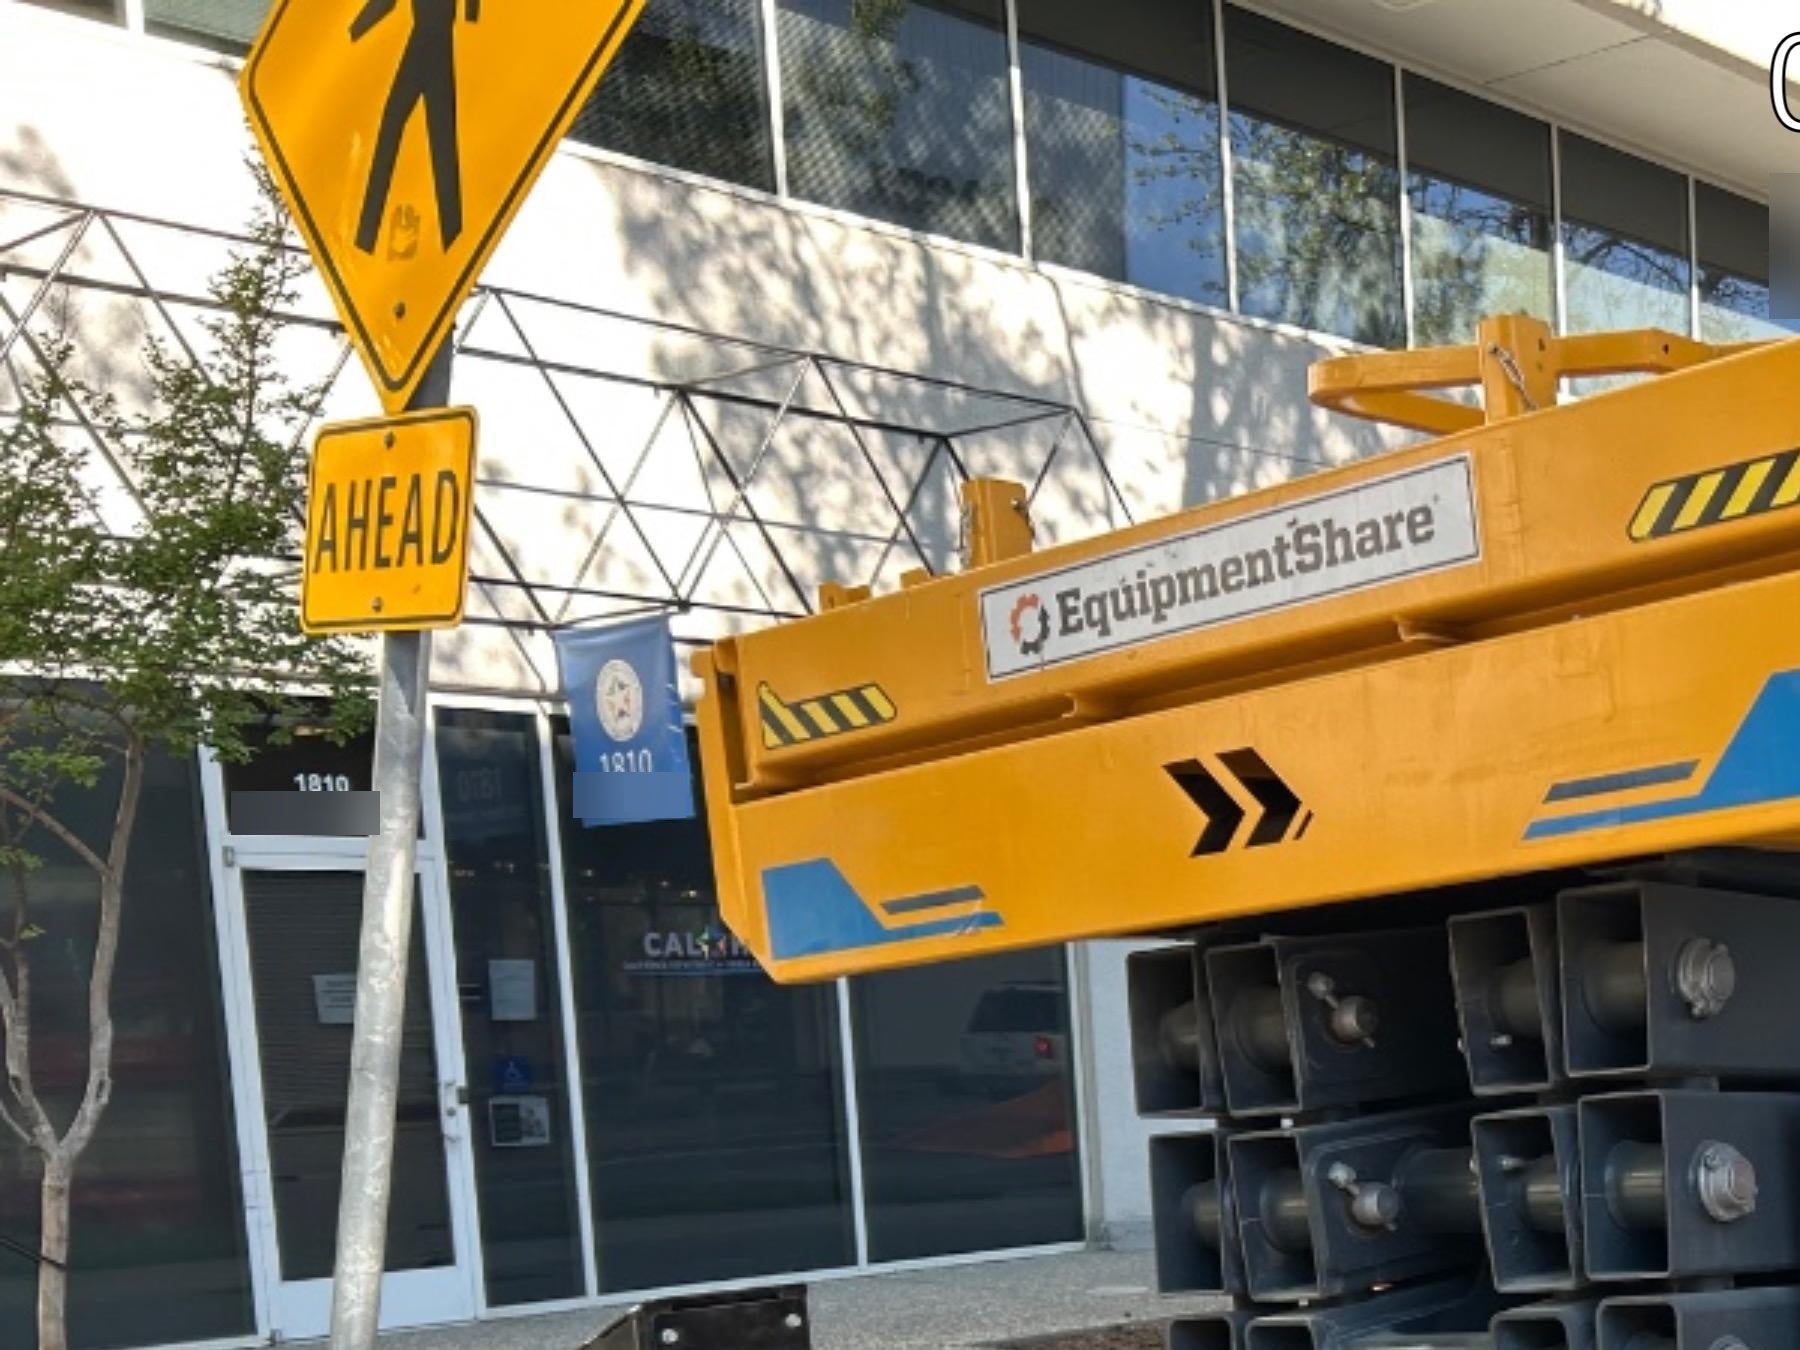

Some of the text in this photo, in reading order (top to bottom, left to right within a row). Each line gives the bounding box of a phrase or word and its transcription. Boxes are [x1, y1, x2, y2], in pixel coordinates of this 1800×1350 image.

[313, 470, 460, 574] AHEAD
[1056, 504, 1435, 638] EquipmentShare
[293, 773, 350, 792] 1810
[599, 748, 653, 773] 1810
